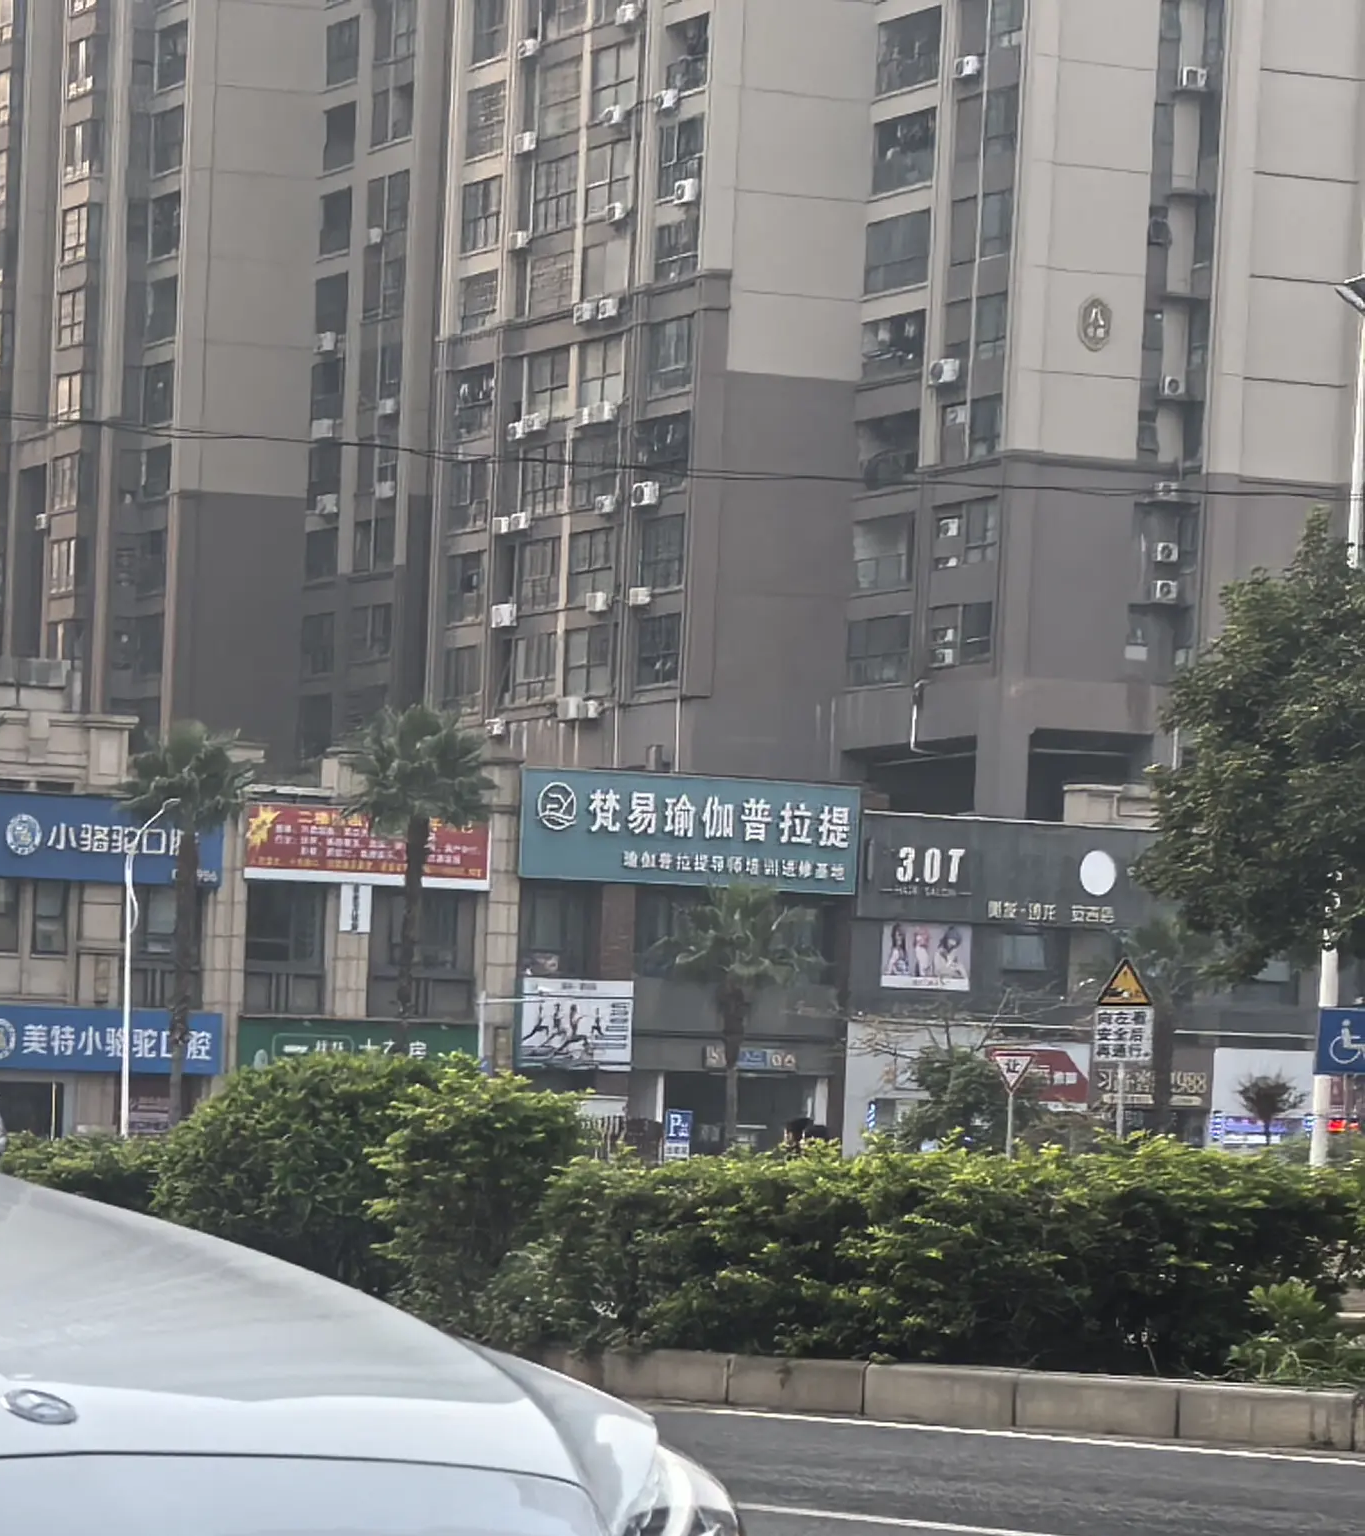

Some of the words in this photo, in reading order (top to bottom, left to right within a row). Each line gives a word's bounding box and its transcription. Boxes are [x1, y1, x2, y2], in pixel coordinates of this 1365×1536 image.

[588, 788, 851, 848] 梵易瑜伽普拉提
[1098, 1011, 1146, 1025] 向左看
[1098, 1028, 1145, 1042] 安全后
[1005, 1059, 1020, 1074] 让
